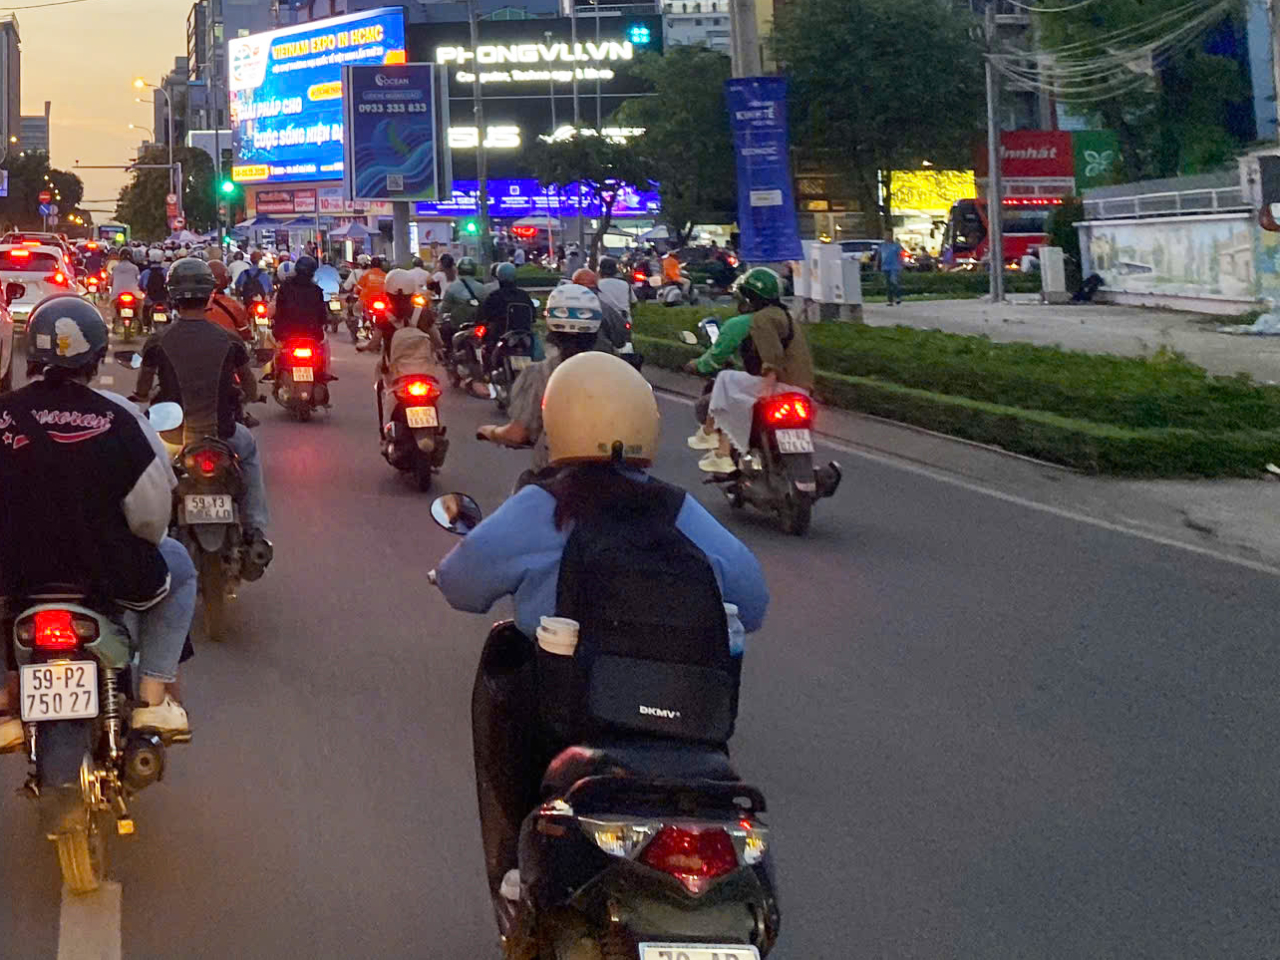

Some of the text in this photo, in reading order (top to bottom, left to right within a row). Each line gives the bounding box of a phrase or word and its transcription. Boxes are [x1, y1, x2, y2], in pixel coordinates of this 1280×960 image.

[272, 25, 384, 60] VIETNAM EXPO IN HCMC
[359, 104, 383, 112] 0933
[387, 104, 405, 112] 333
[32, 666, 85, 691] 59-P2
